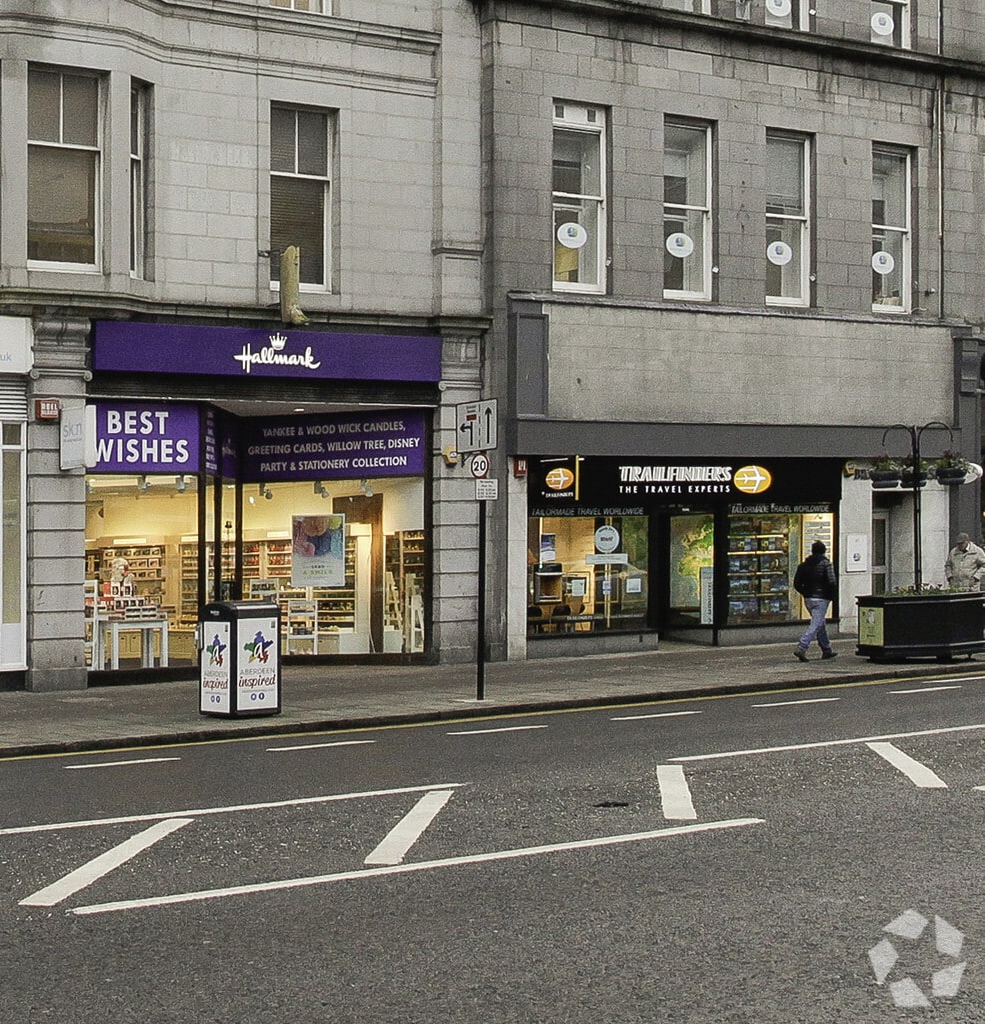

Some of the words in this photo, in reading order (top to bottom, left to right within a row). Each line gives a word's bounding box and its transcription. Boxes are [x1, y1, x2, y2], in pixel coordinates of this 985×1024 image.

[233, 342, 322, 374] Hallmark
[107, 410, 169, 435] BEST
[262, 426, 296, 437] YANKEE
[306, 424, 336, 435] WOOD
[337, 423, 361, 434] WICK
[363, 420, 406, 433] CANDLES,
[96, 438, 190, 464] WISHES
[247, 444, 291, 456] GREETING
[293, 442, 326, 454] CARDS,
[326, 440, 362, 452] WILLOW
[363, 439, 387, 451] TREE,
[387, 437, 421, 449] DISNEY
[260, 461, 288, 472] PARTY
[289, 461, 297, 471] &
[298, 458, 350, 471] STATIONERY
[352, 455, 408, 468] COLLECTION
[473, 460, 487, 472] 20
[618, 465, 733, 482] TRAILFINDERS
[619, 485, 639, 493] THE
[645, 485, 682, 493] TRAVEL
[688, 484, 731, 493] EXPERTS
[577, 507, 602, 516] TRAVEL
[240, 667, 276, 676] ABERDEEN
[238, 674, 277, 689] inspired
